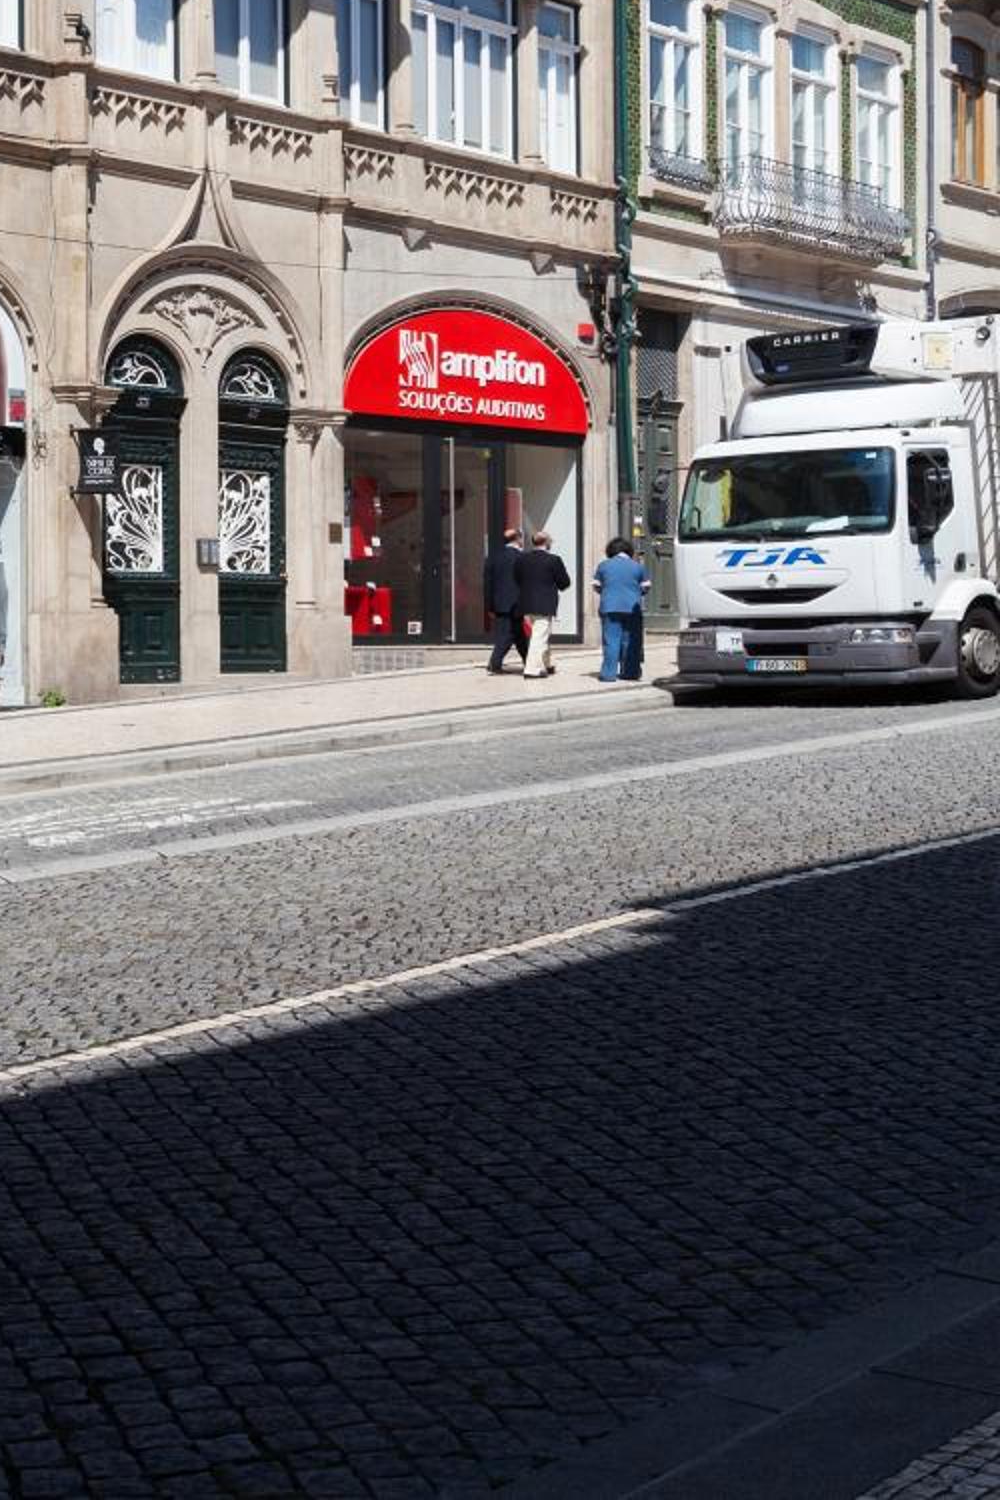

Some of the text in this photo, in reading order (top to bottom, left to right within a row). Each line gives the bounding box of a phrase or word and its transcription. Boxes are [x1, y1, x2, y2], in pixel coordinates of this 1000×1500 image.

[773, 331, 840, 347] CARRIER
[440, 349, 546, 387] amplifon
[398, 390, 546, 421] SOLUÇÕES AUDITIVAS
[721, 546, 827, 567] TJA
